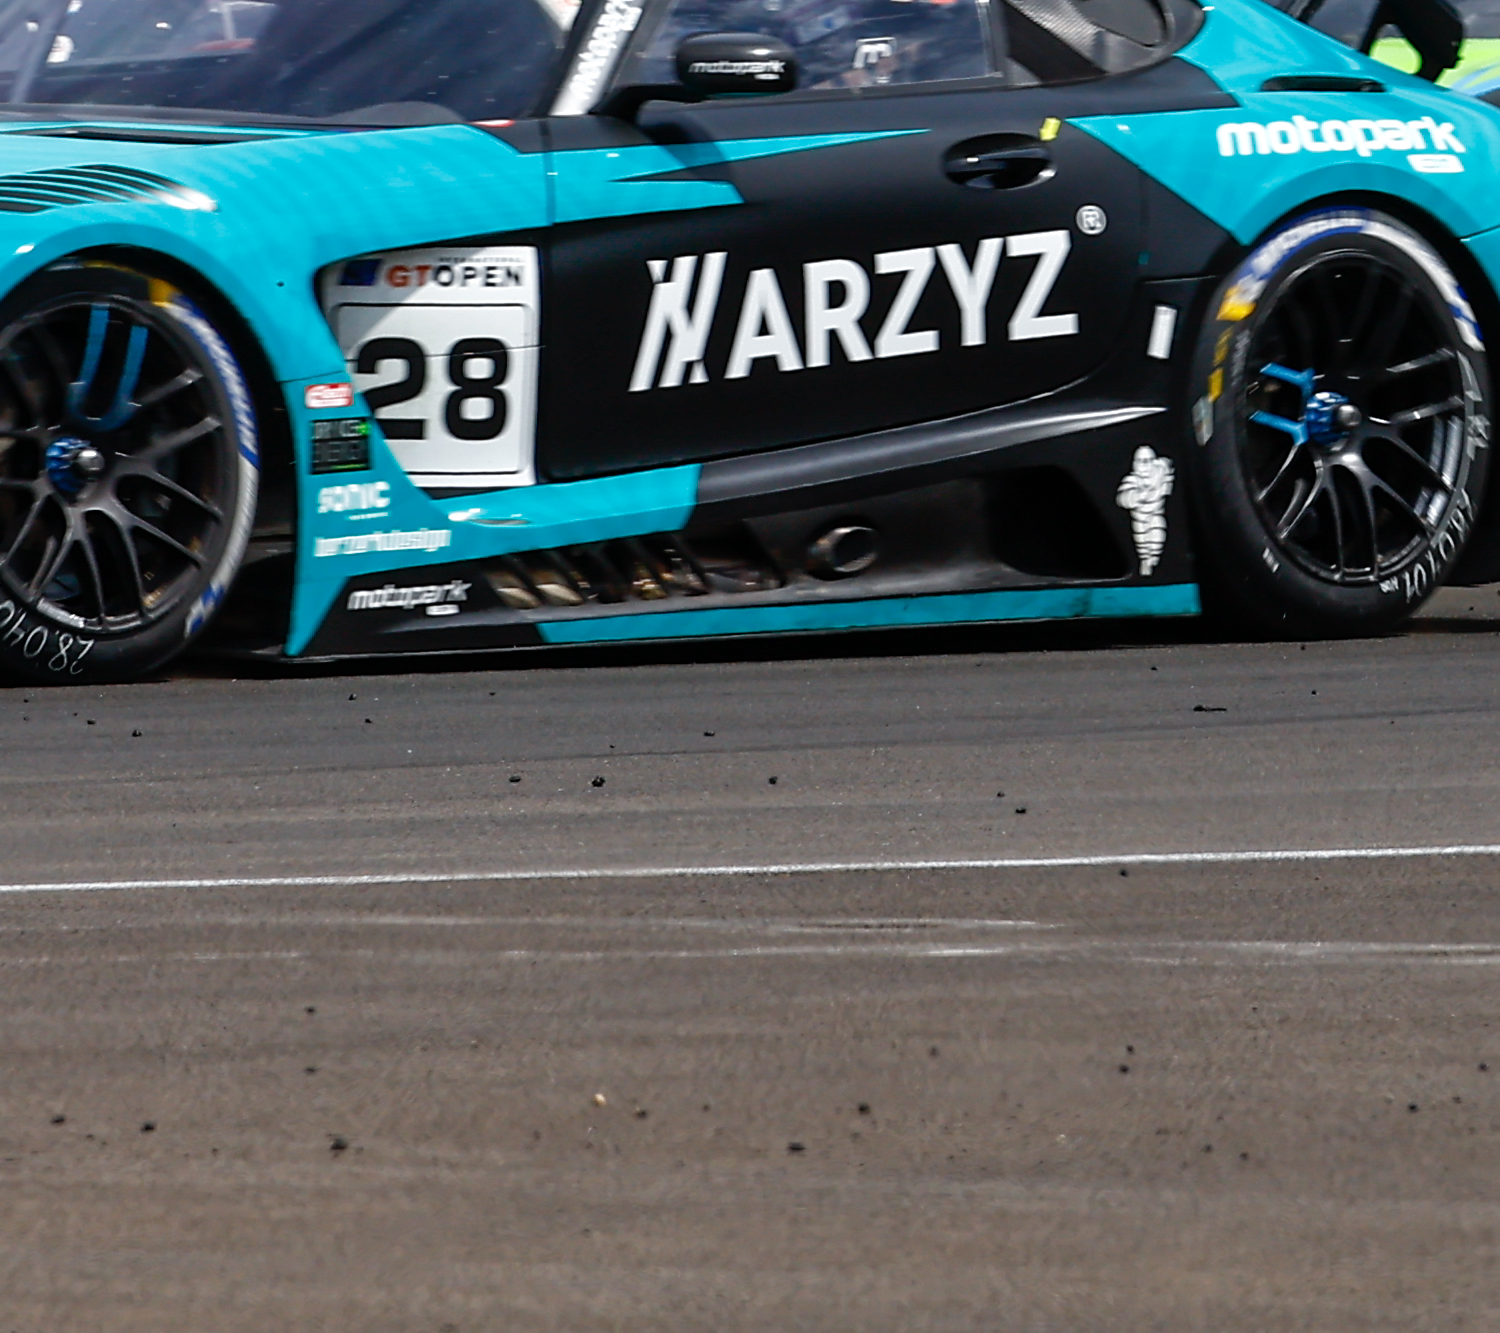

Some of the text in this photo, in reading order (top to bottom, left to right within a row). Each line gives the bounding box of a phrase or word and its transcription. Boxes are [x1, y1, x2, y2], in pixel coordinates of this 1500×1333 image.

[1215, 115, 1467, 158] motopark
[356, 336, 509, 441] 28
[346, 579, 473, 610] motopark
